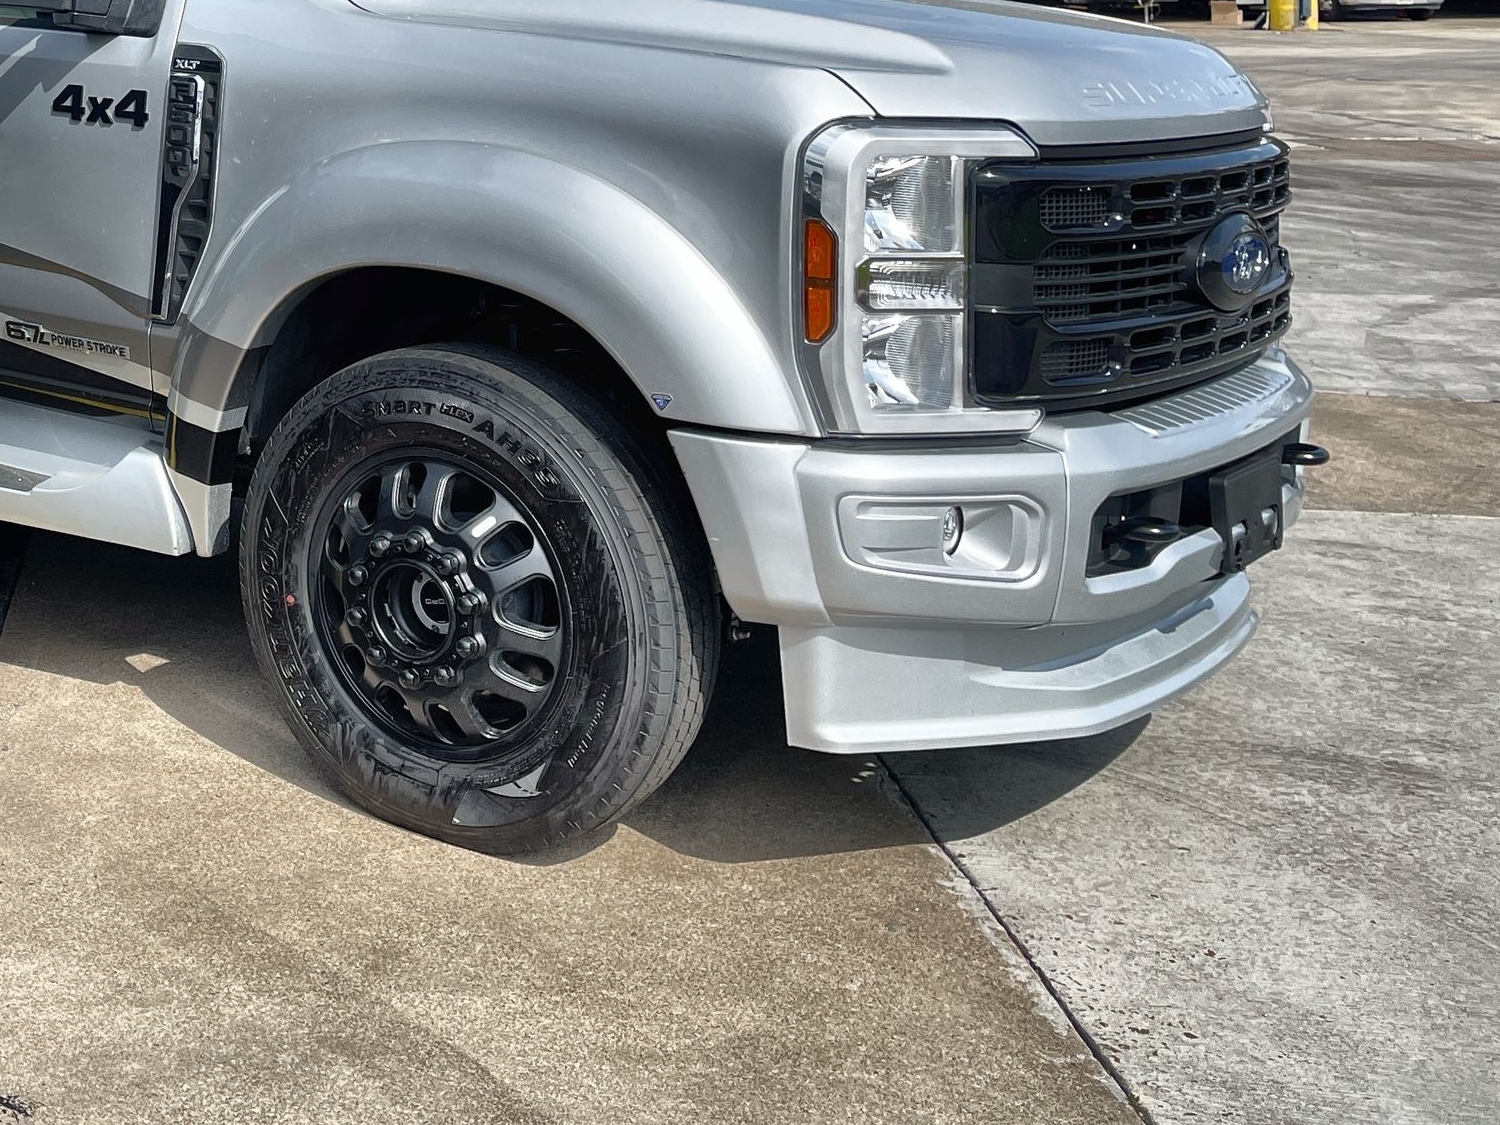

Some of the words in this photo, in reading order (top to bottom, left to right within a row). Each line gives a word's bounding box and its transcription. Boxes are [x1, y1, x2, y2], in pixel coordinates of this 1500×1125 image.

[174, 59, 200, 70] XLT
[51, 83, 149, 127] 4x4
[5, 320, 50, 346] 6.7L
[50, 334, 84, 350] POWER
[87, 341, 127, 357] STROKE
[472, 419, 562, 488] AH35
